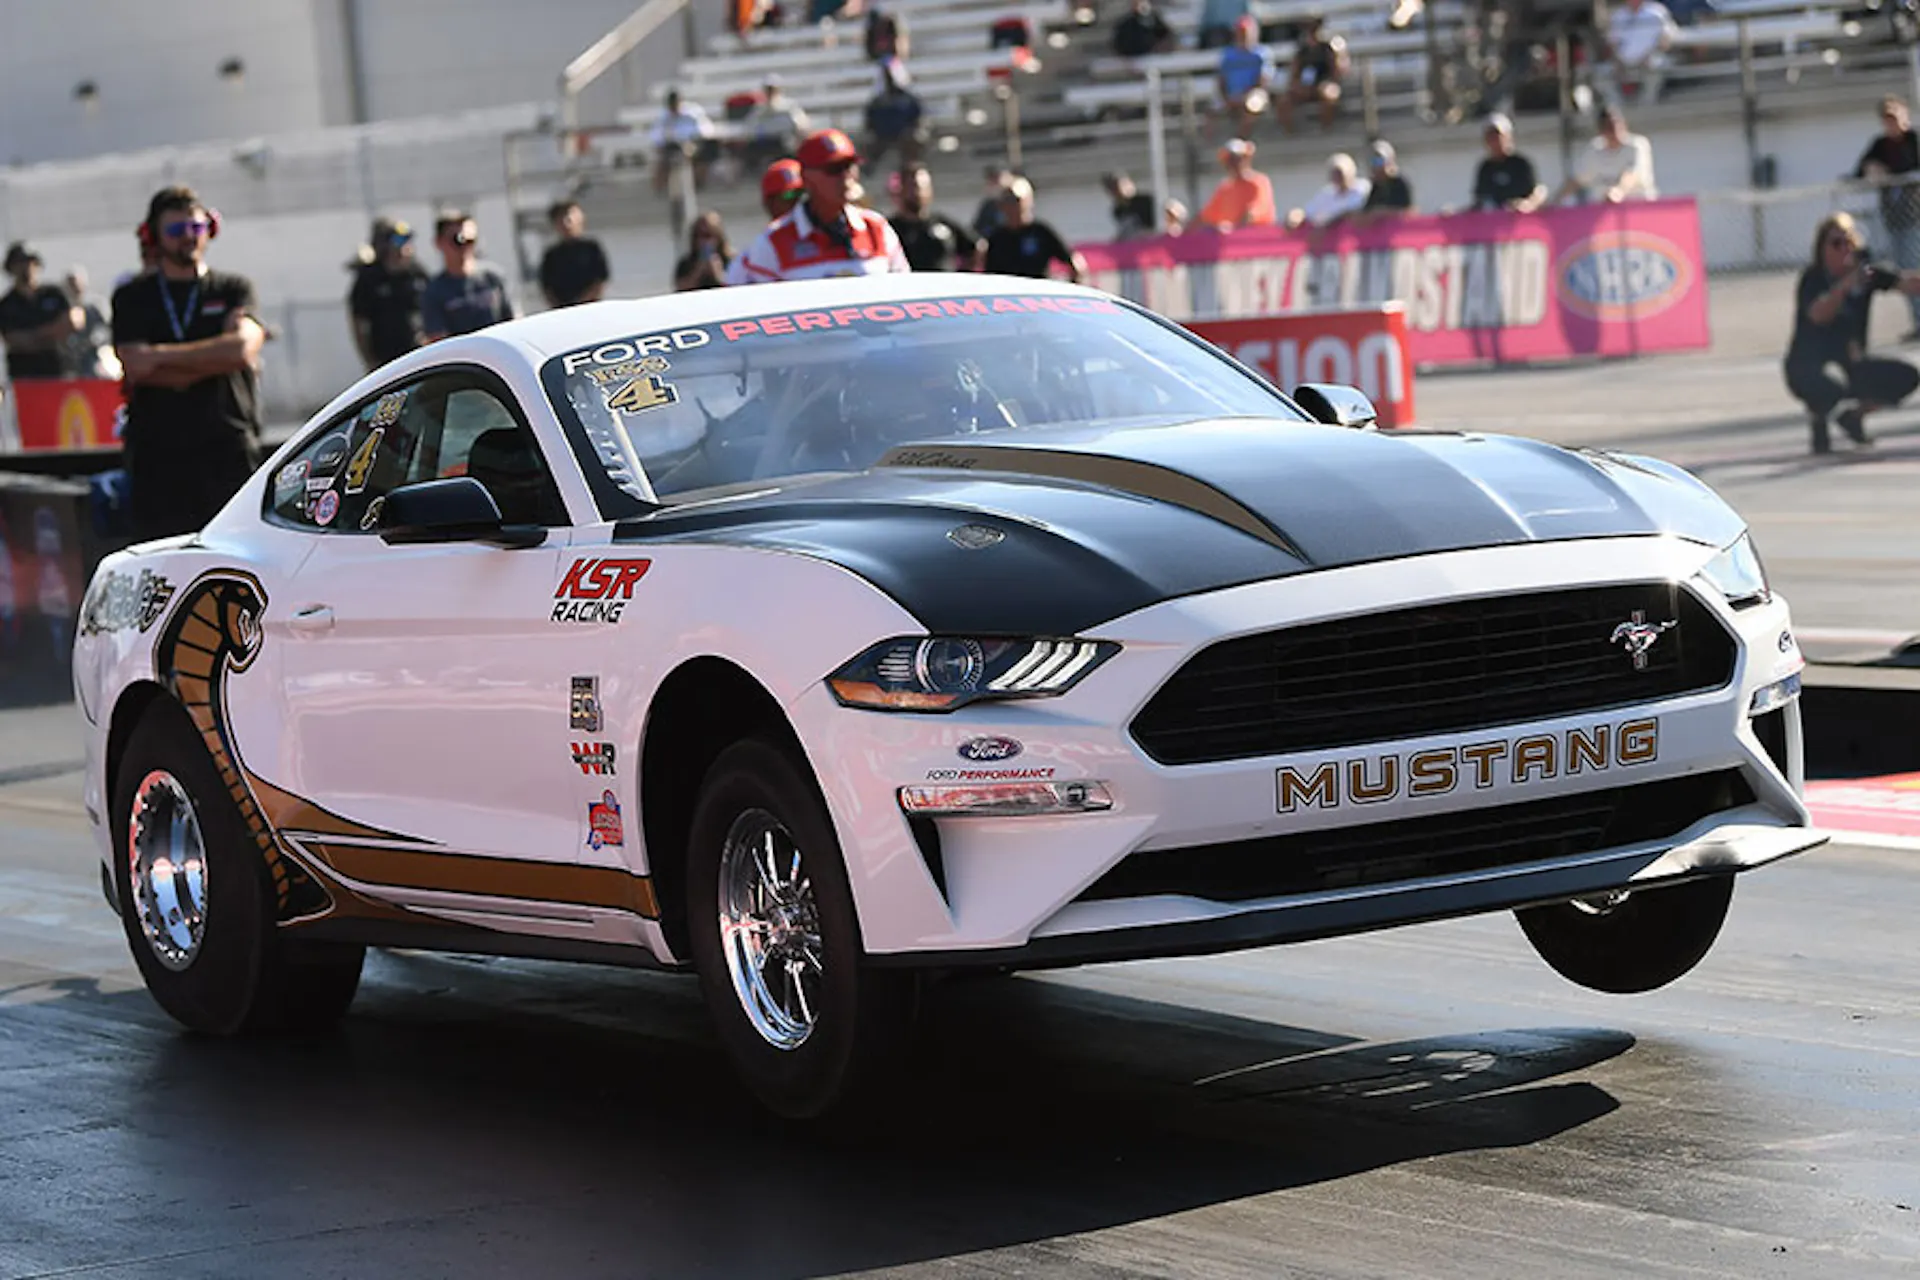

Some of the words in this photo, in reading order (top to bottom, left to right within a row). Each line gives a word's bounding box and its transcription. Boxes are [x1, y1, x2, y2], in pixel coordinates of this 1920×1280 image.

[1297, 240, 1549, 332] GRANDSTAND
[1564, 248, 1678, 304] NHRA
[562, 329, 710, 376] FORD
[720, 294, 1123, 342] PERFORMANCE
[608, 376, 679, 414] 4
[345, 428, 386, 494] 4
[554, 558, 651, 599] KSR
[550, 601, 625, 623] RACING
[958, 767, 1056, 780] PERFORMANCE
[967, 740, 1012, 759] Ford
[1276, 717, 1658, 813] MUSTANG
